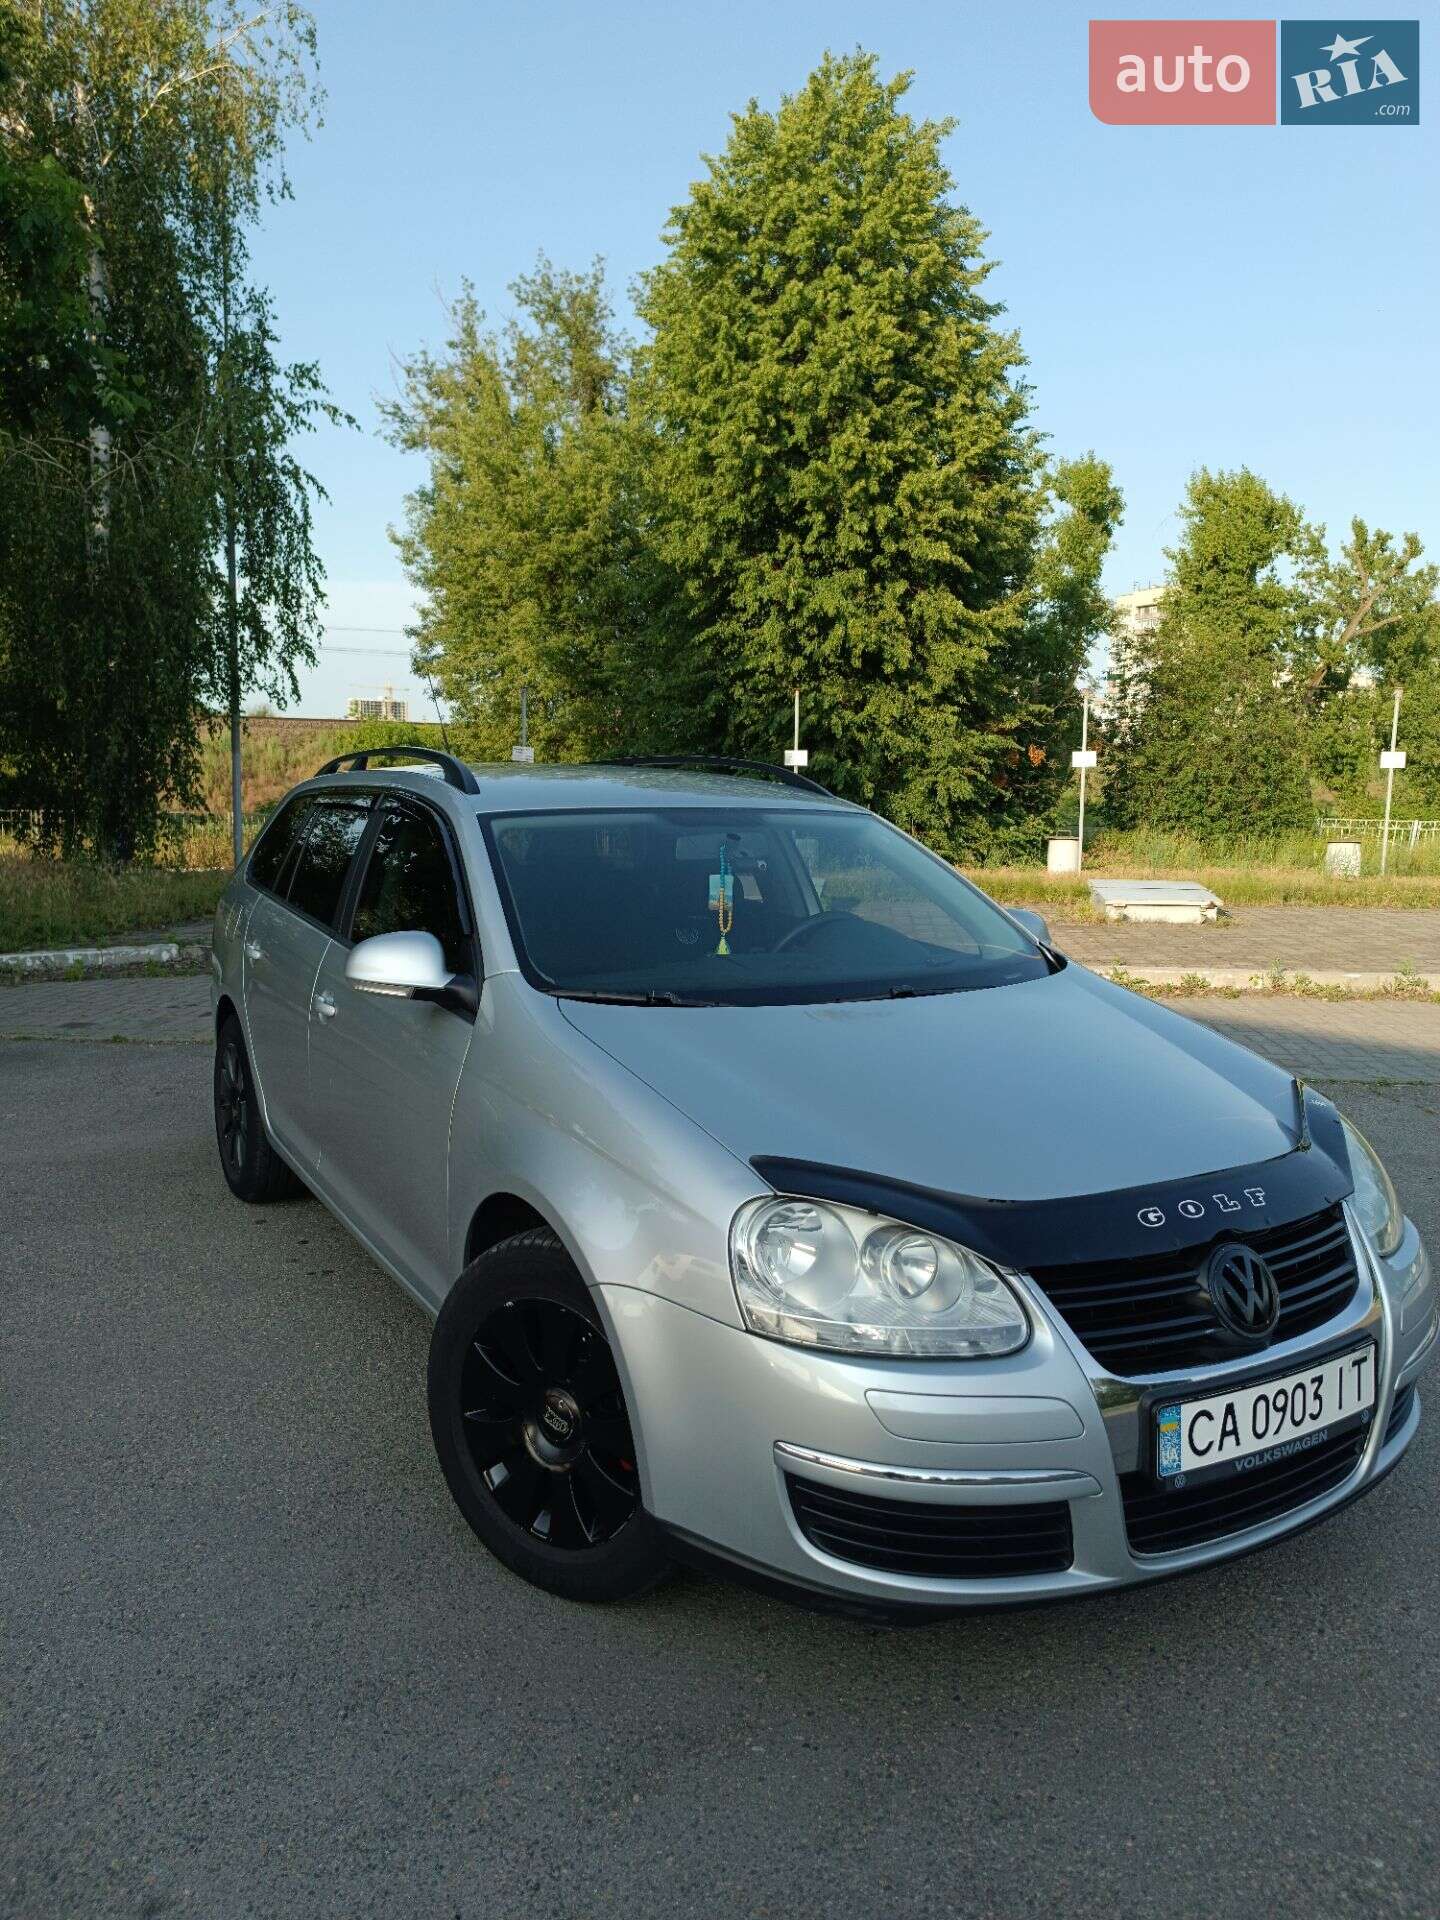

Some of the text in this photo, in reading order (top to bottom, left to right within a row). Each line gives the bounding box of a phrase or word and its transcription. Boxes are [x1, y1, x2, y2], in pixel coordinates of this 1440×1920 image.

[1137, 1187, 1266, 1227] GOLF
[1188, 1402, 1240, 1457] CA
[1252, 1374, 1323, 1440] 0903
[1338, 1355, 1368, 1411] IT
[1235, 1429, 1328, 1472] VOLKSWAGEN
